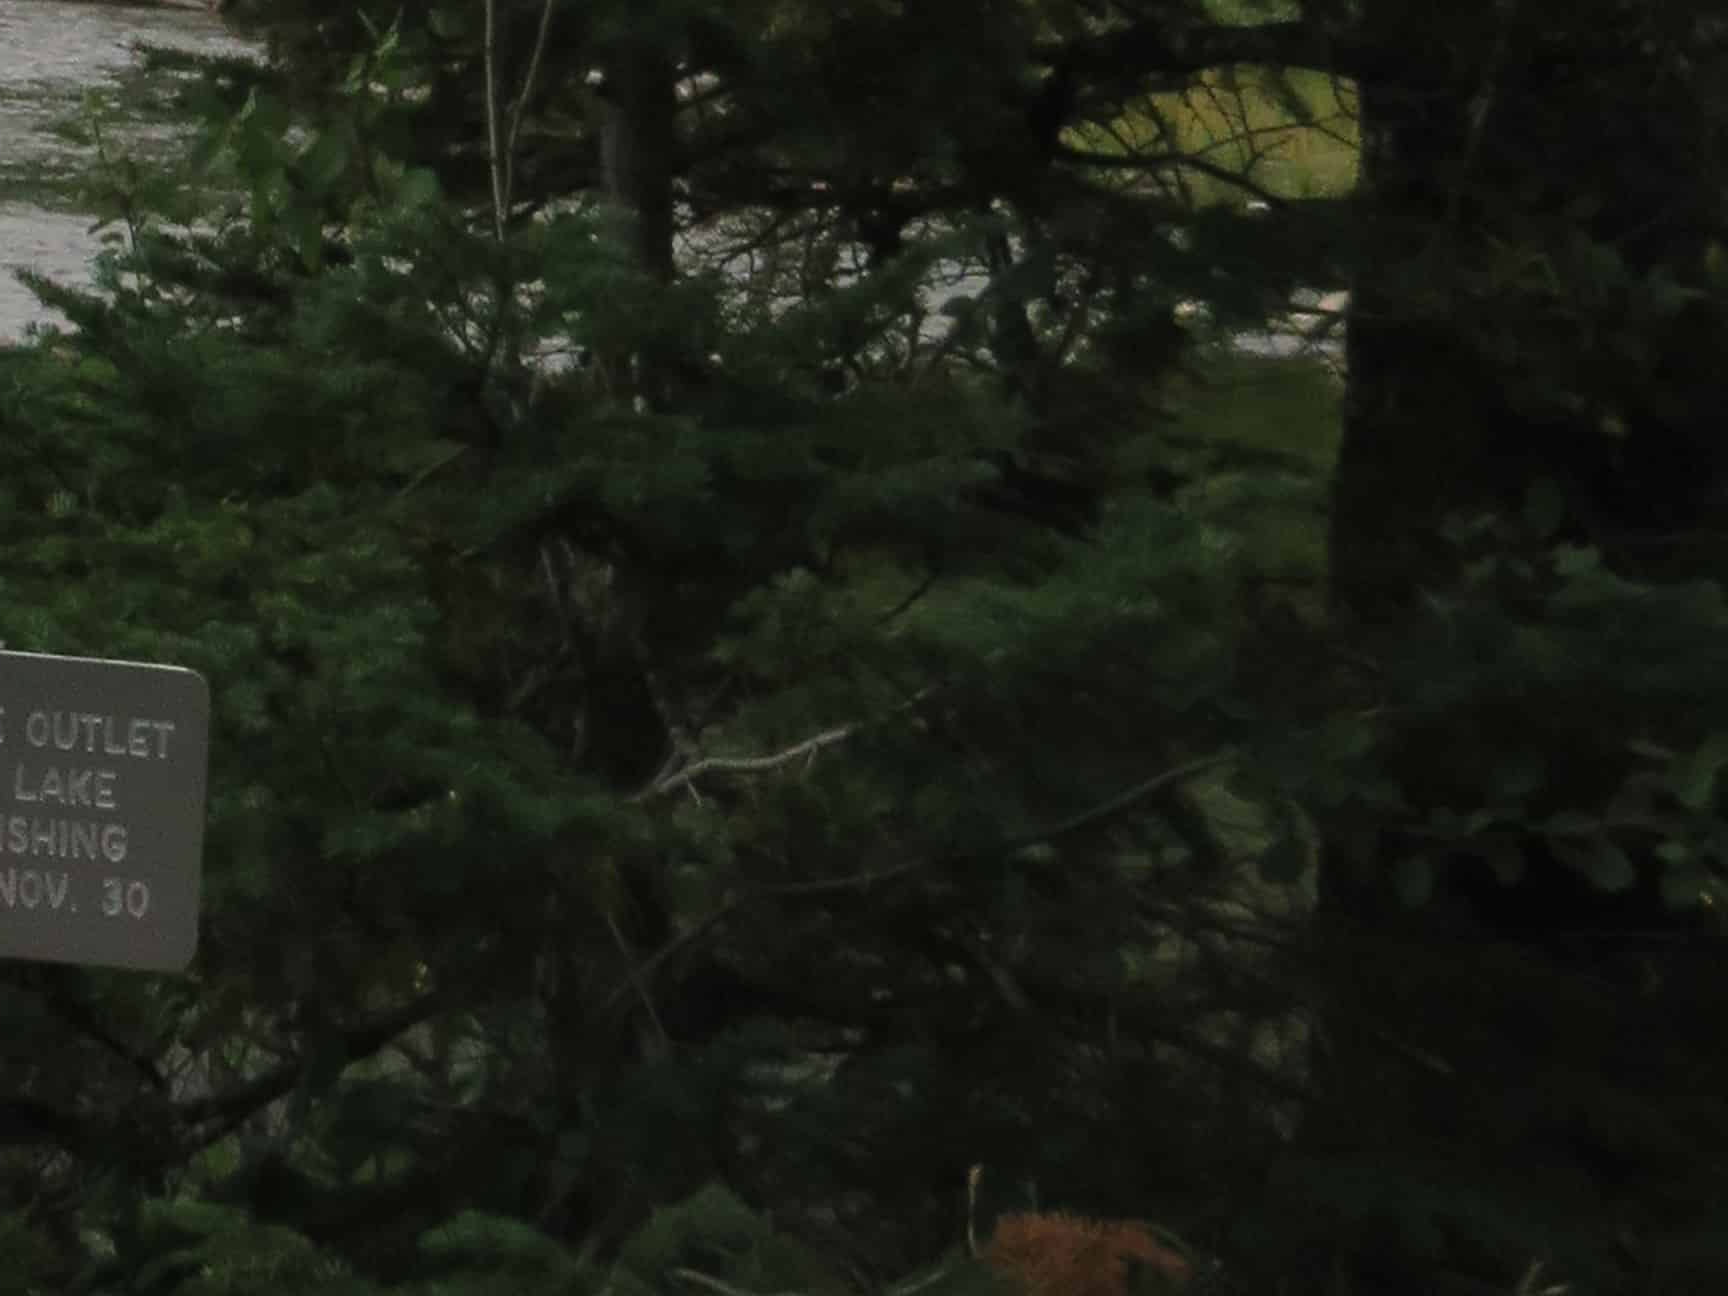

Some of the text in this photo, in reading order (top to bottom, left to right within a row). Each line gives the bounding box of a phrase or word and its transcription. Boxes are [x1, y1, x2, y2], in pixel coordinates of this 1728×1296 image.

[26, 709, 176, 759] OUTLET
[14, 761, 118, 809] LAKE
[101, 877, 150, 919] 30
